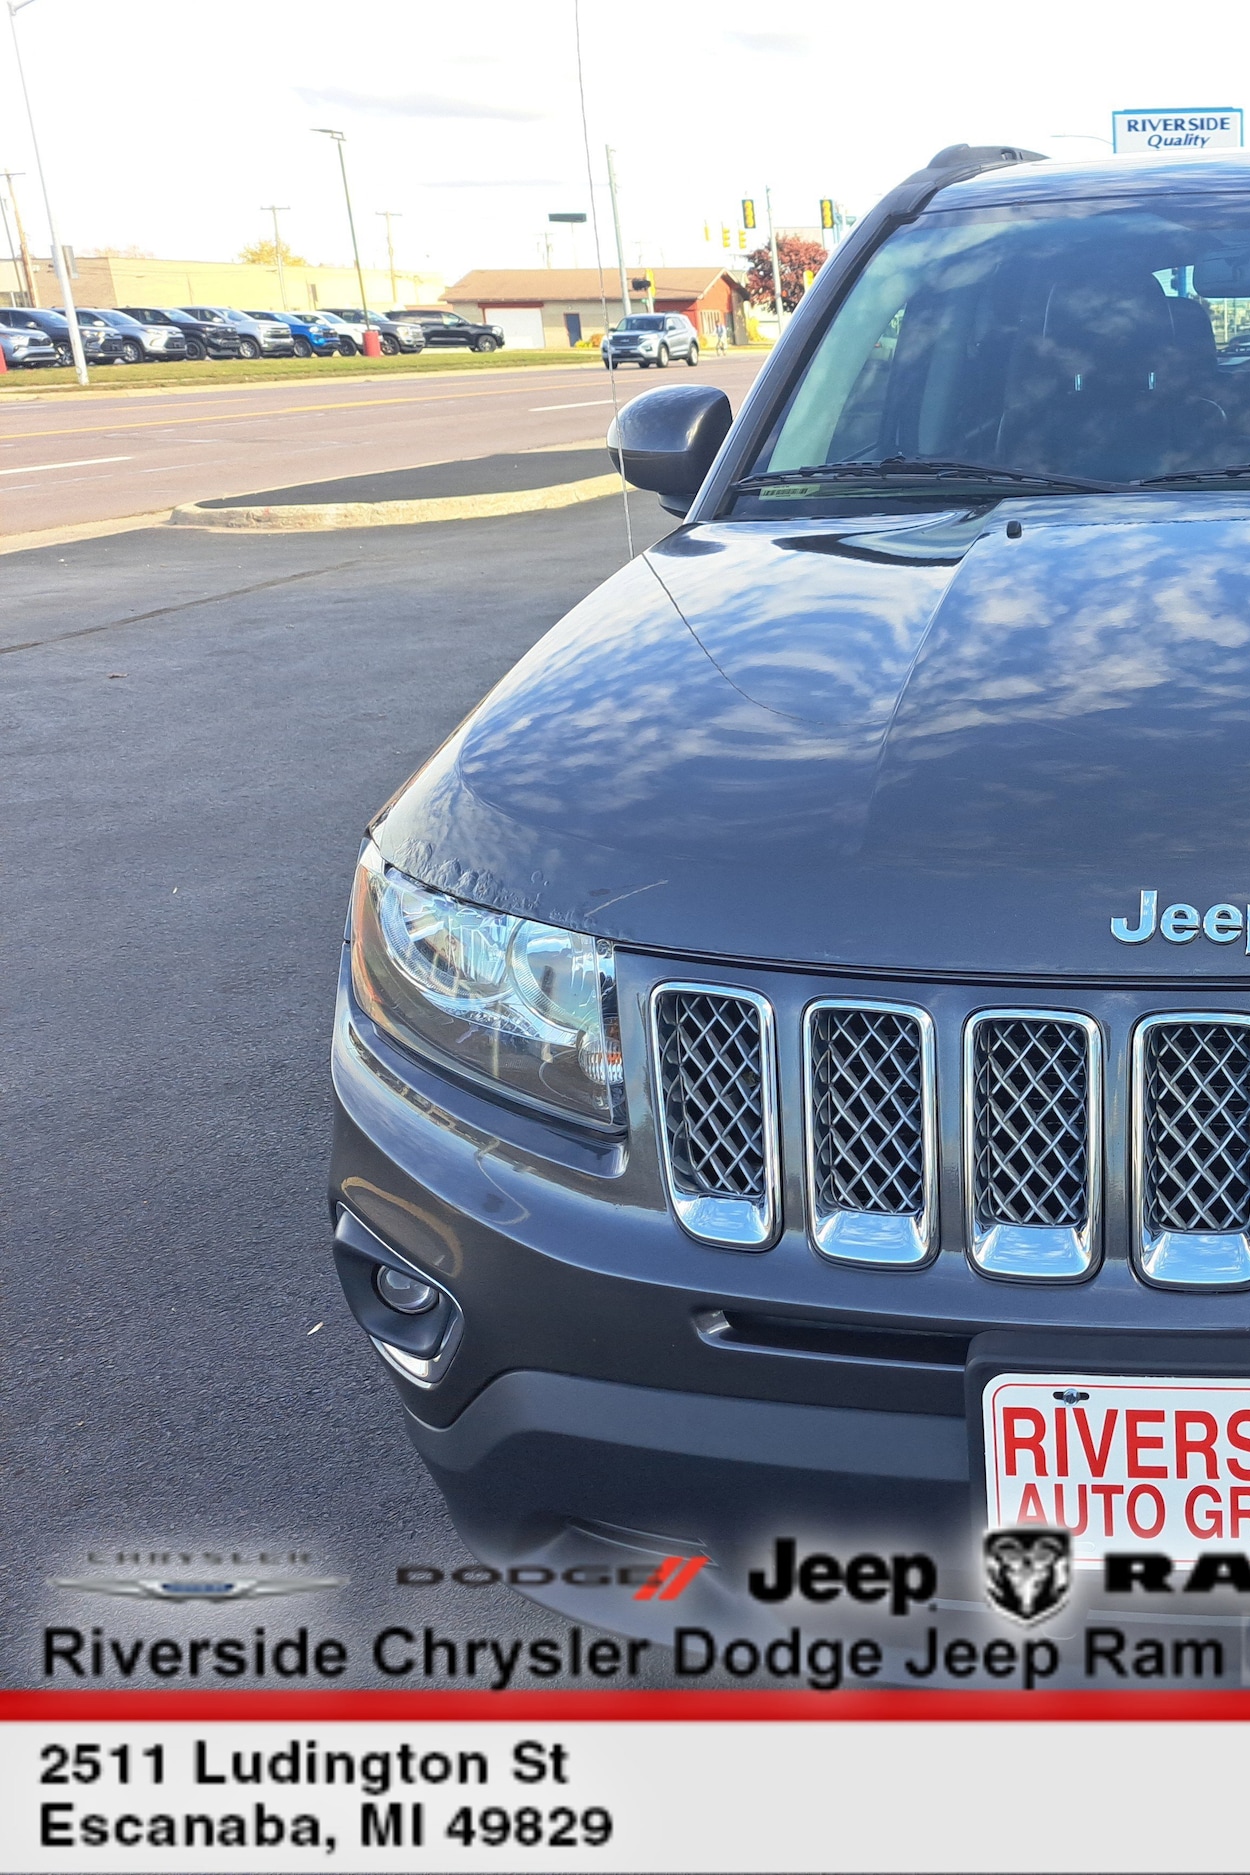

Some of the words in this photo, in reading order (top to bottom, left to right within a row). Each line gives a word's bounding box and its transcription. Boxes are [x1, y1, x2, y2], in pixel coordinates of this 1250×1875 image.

[1127, 117, 1230, 132] RIVERSIDE
[1147, 133, 1210, 148] Quality
[1015, 1482, 1167, 1539] AUTO
